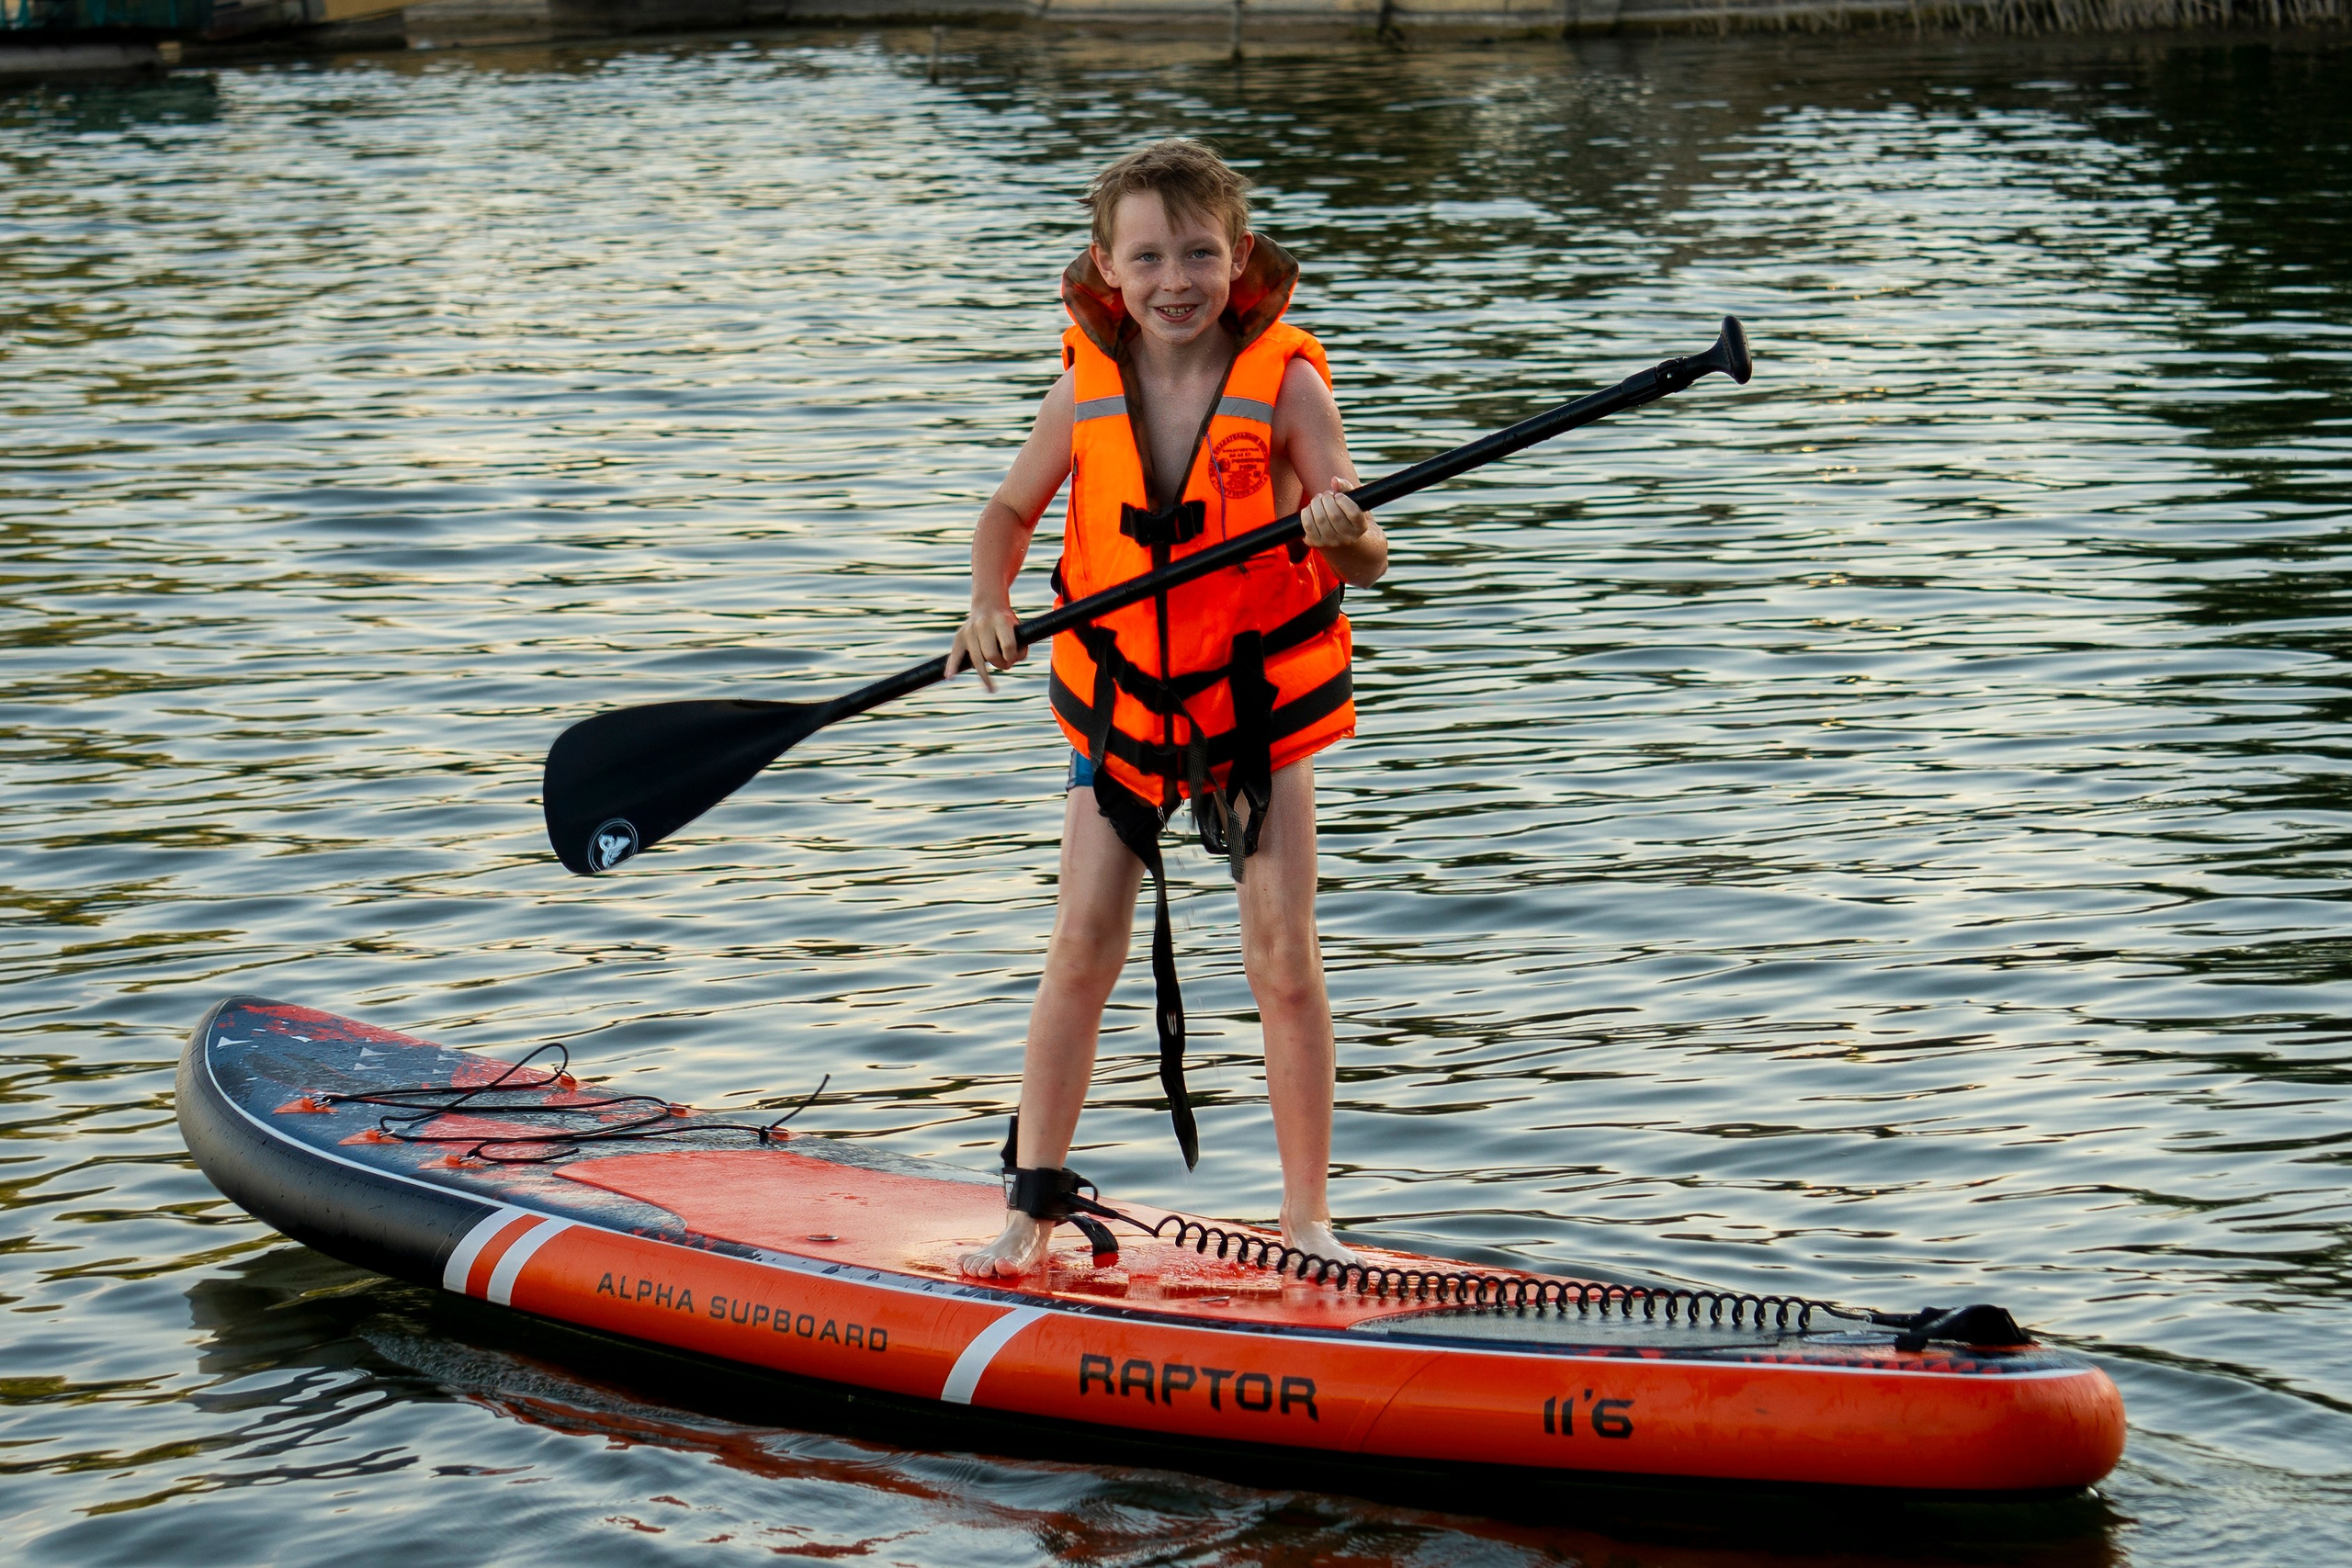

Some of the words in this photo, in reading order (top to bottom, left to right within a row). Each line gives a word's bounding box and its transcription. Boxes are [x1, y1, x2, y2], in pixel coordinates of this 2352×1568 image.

[596, 1272, 694, 1314] ALPHA
[709, 1296, 888, 1351] SUPBOARD
[1080, 1354, 1319, 1422] RAPTOR
